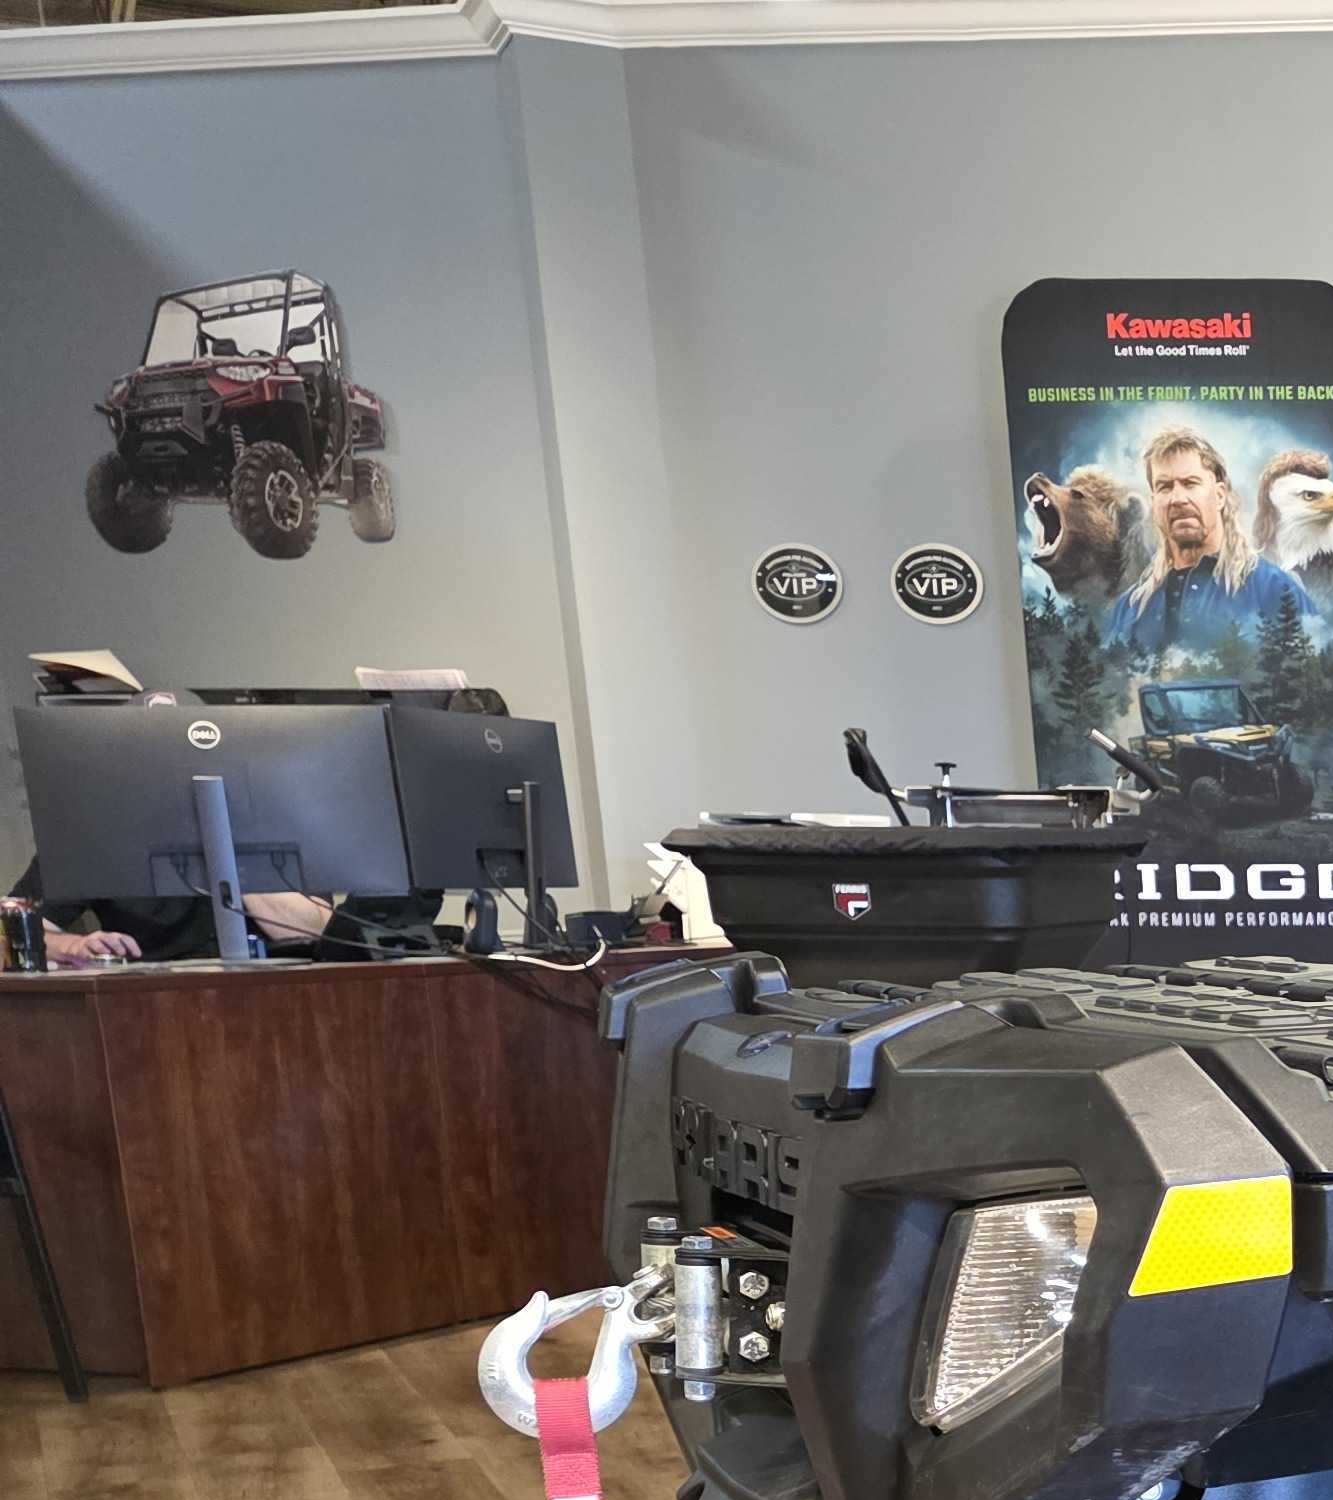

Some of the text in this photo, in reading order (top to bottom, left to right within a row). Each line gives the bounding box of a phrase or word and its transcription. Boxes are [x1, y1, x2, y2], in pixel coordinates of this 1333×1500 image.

[1106, 313, 1252, 338] Kawasaki
[1114, 345, 1132, 356] Let
[1136, 345, 1154, 356] the
[1156, 345, 1186, 356] Good
[1188, 345, 1222, 356] Times
[1028, 387, 1096, 402] BUSINESS
[1100, 387, 1113, 401] IN
[1118, 386, 1144, 401] THE
[1148, 386, 1196, 401] FRONT.
[1200, 386, 1244, 400] PARTY
[1249, 386, 1263, 400] IN
[1267, 386, 1294, 400] THE
[772, 577, 817, 595] VIP
[912, 578, 958, 596] VIP
[1138, 911, 1216, 927] PREMIUM
